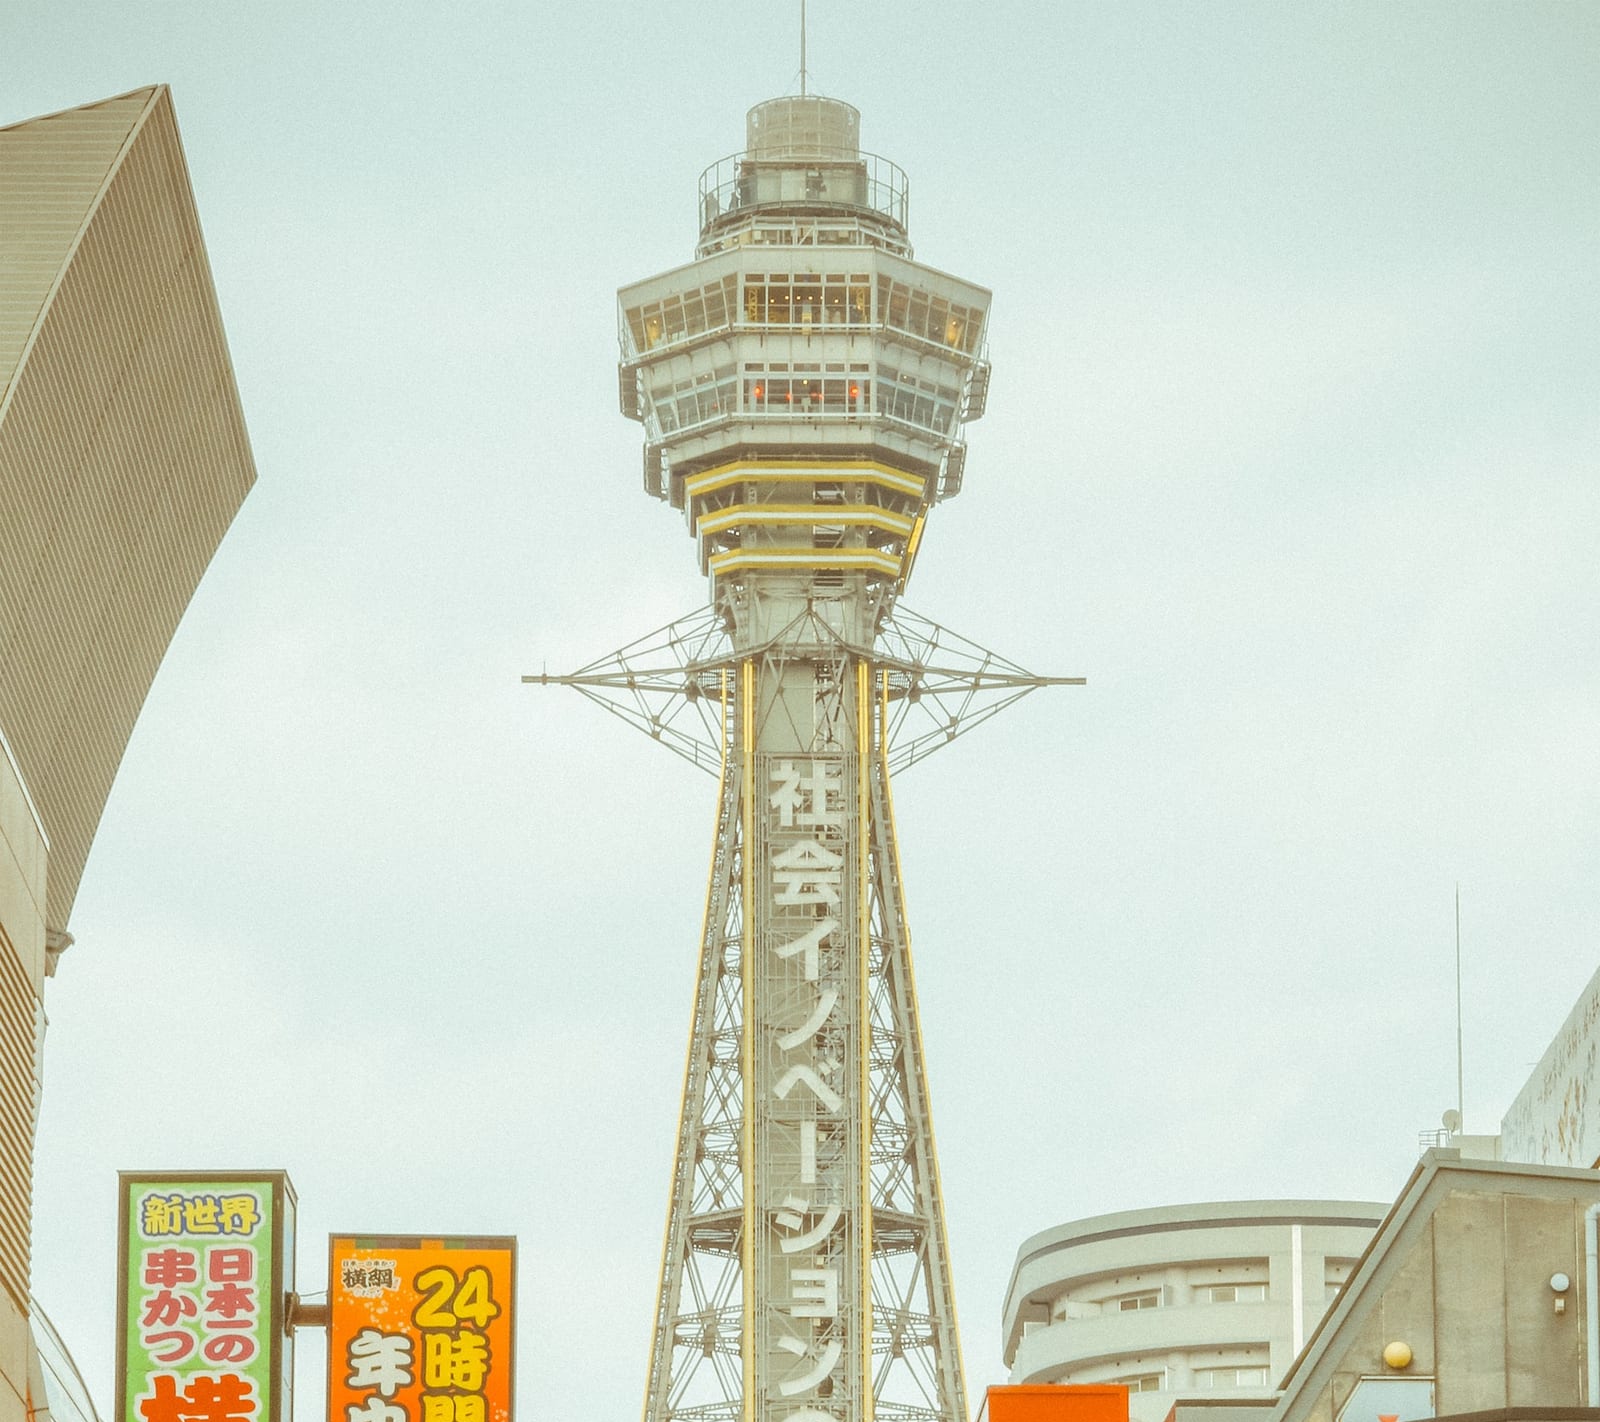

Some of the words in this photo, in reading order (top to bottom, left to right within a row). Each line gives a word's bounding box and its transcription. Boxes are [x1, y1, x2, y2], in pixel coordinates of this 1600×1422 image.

[144, 1194, 260, 1236] 新世界
[144, 1248, 198, 1363] 串かつ
[205, 1249, 256, 1362] 日本一の
